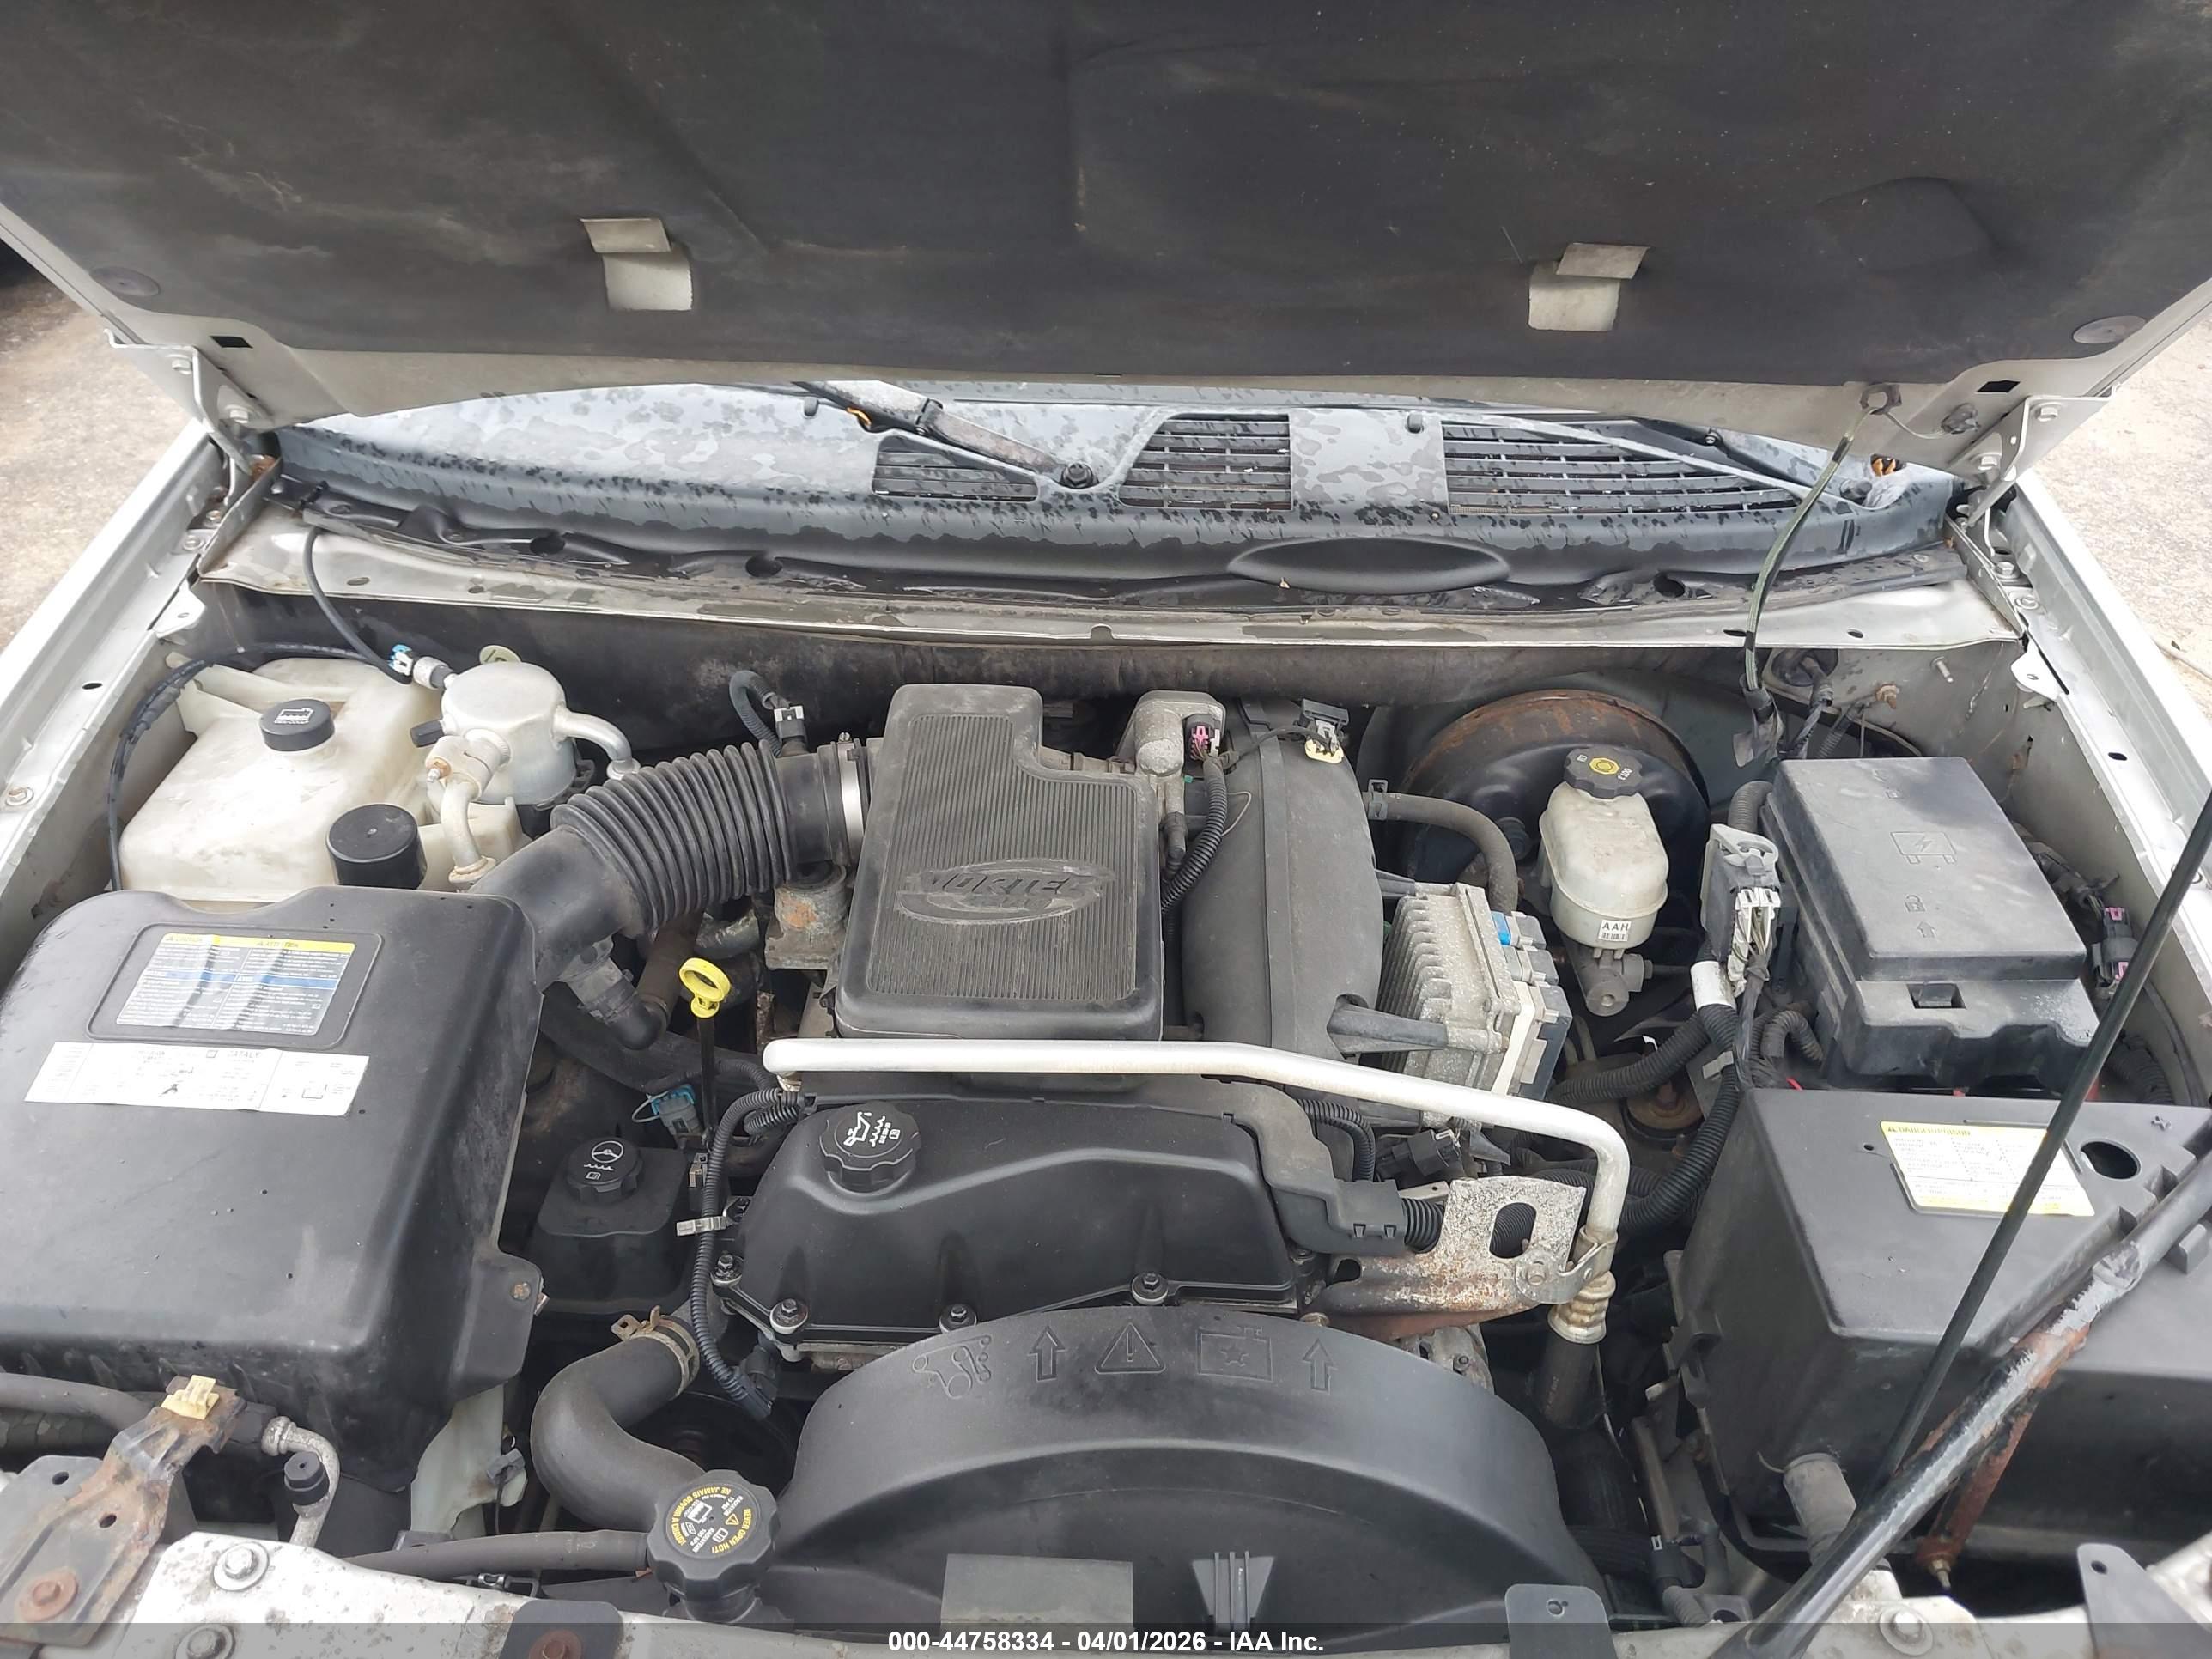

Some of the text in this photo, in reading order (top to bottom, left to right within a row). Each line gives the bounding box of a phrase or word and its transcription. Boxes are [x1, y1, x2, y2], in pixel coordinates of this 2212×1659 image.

[1602, 922, 1629, 931] AAH
[692, 1486, 720, 1499] JAMAIS
[721, 1486, 732, 1496] NE
[711, 1508, 751, 1553] NEVER OPEN HOT!
